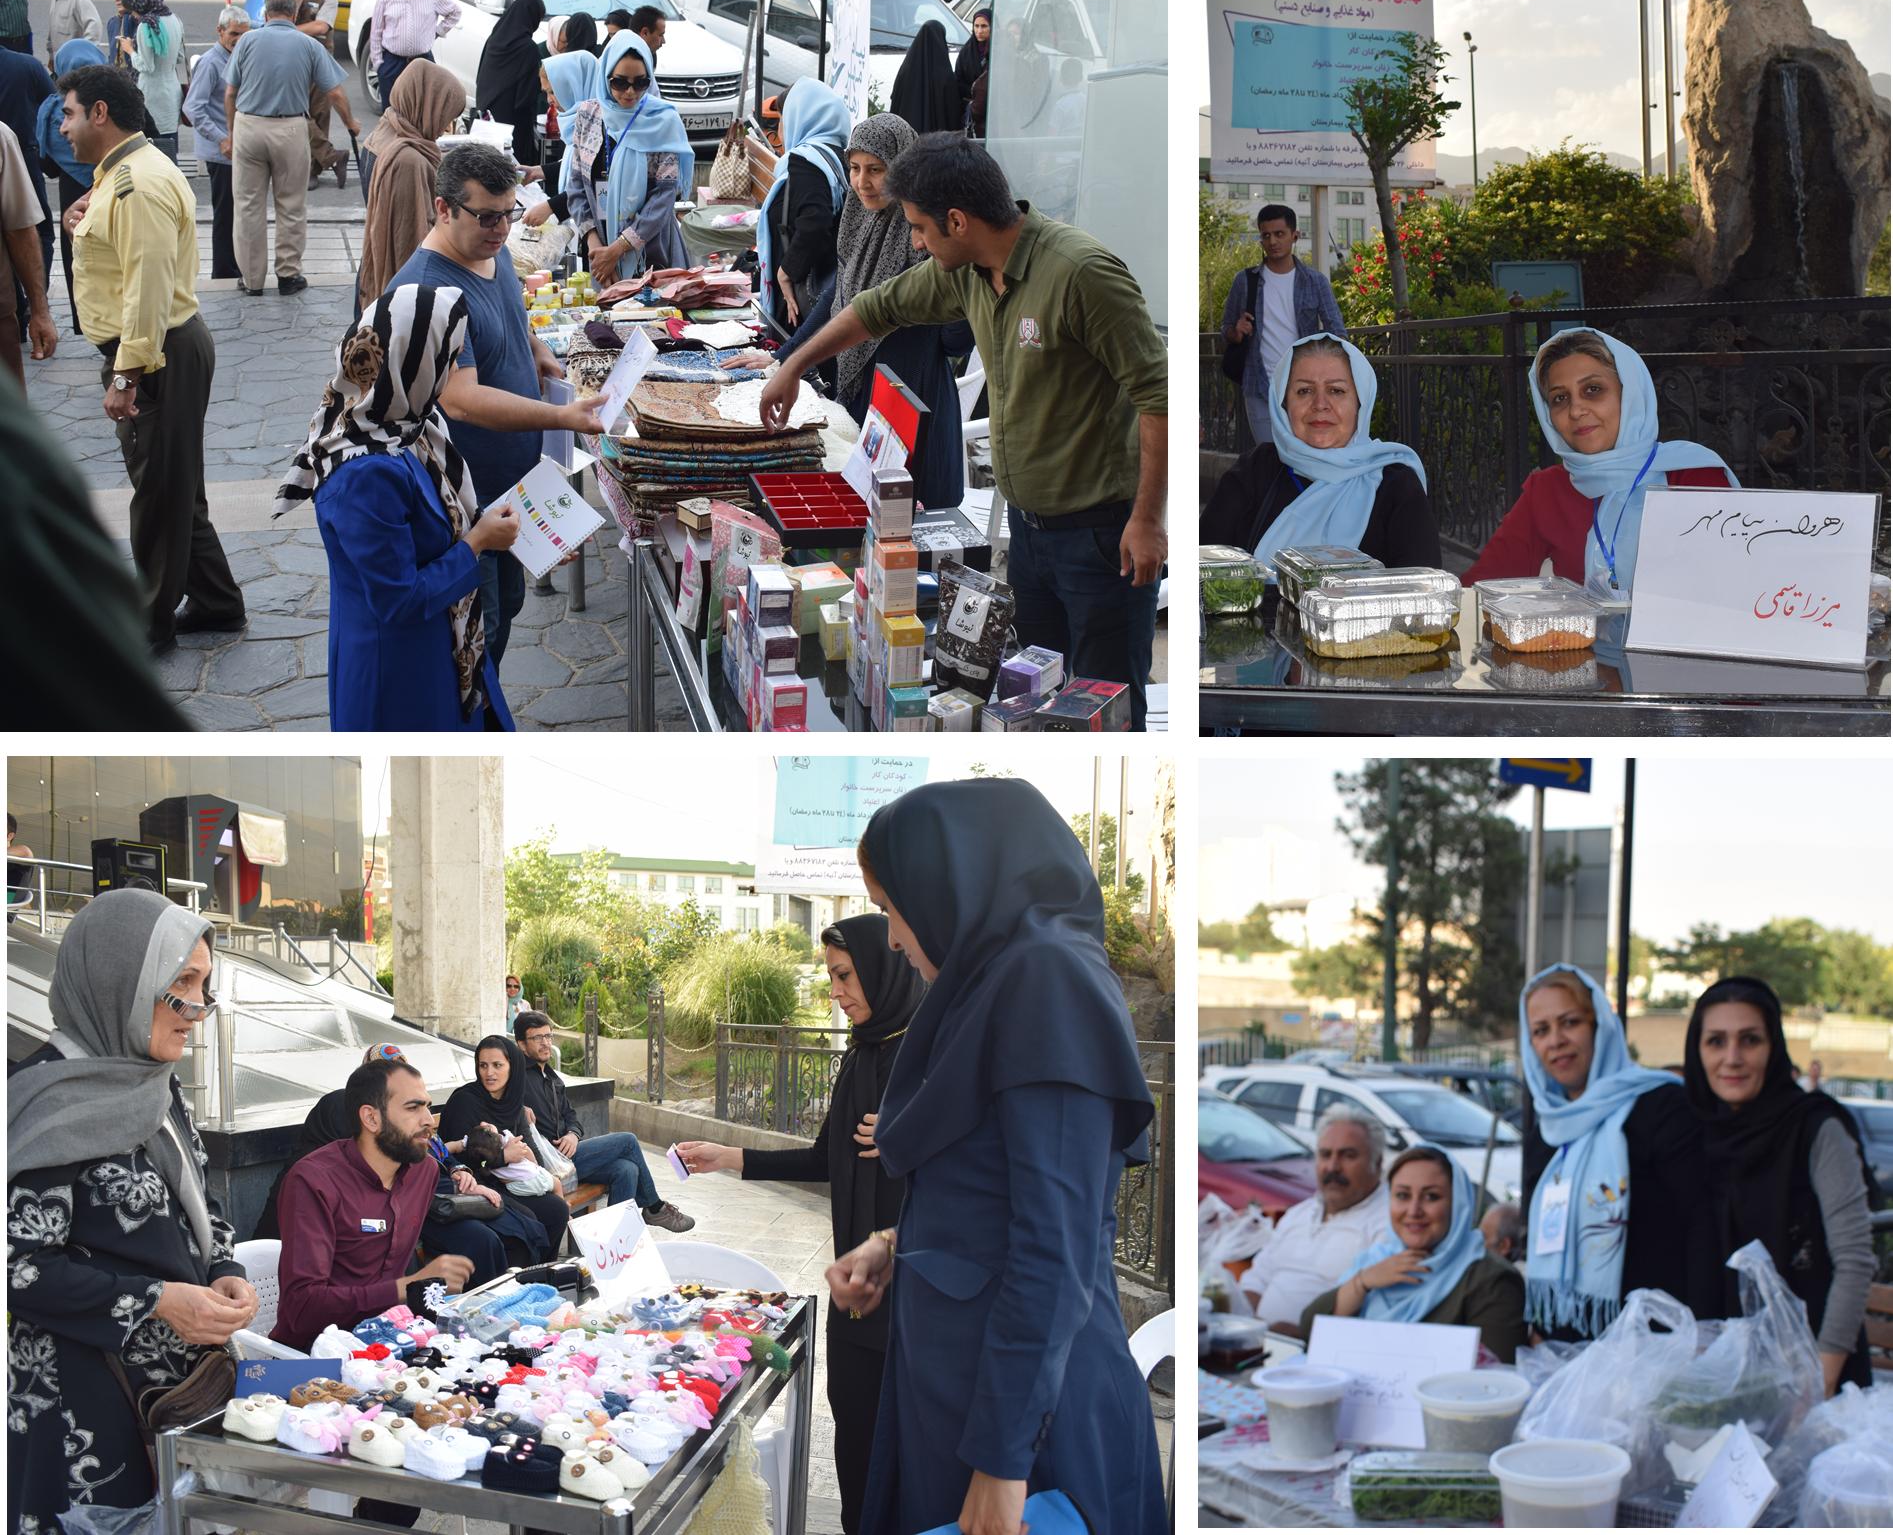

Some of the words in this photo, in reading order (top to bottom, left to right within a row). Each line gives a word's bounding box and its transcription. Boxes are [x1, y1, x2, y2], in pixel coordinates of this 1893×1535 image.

[1679, 509, 1723, 536] مهر
[1720, 512, 1765, 541] پیام
[1747, 514, 1844, 555] رهروان
